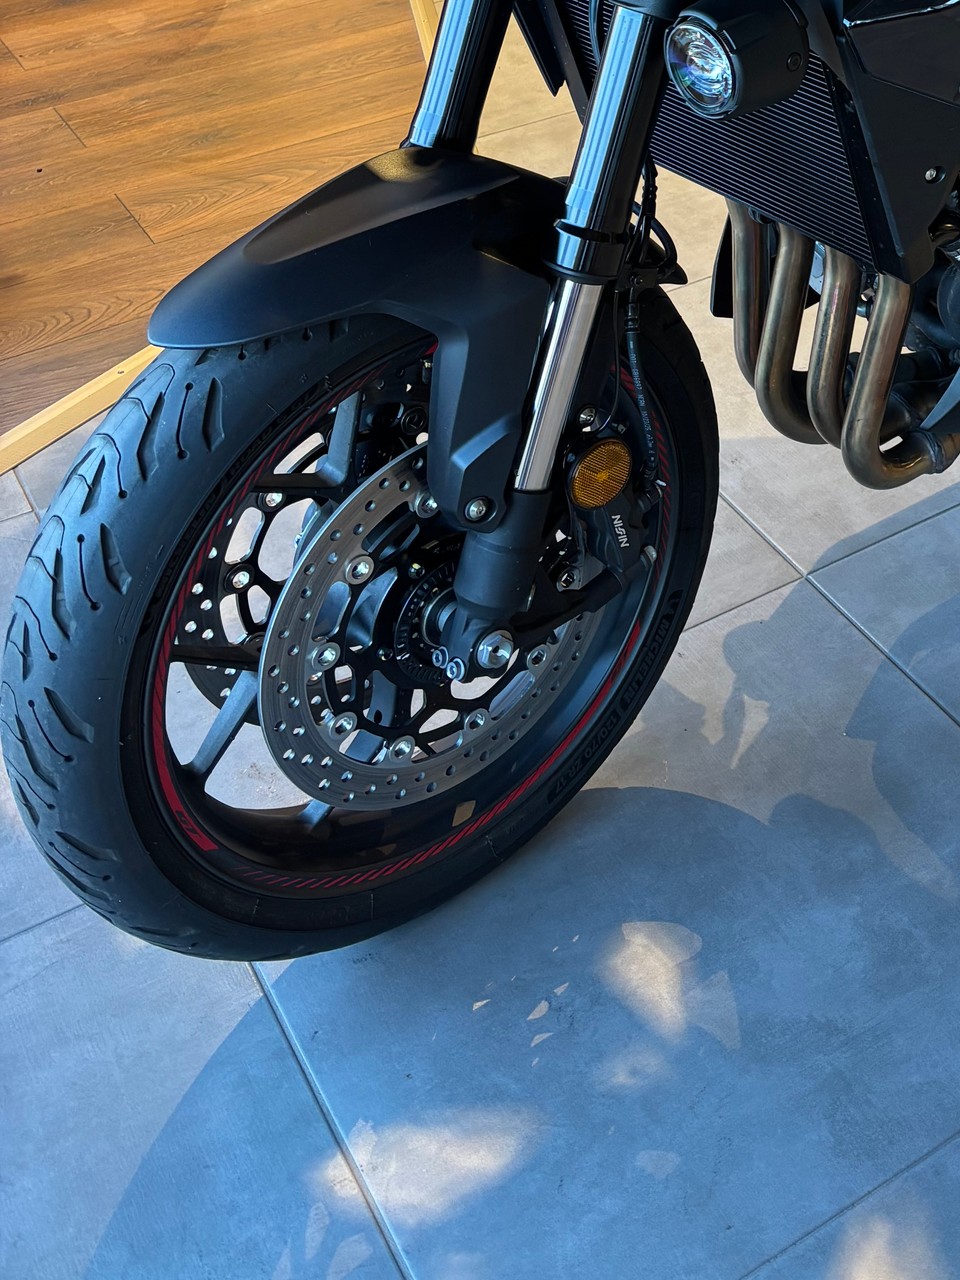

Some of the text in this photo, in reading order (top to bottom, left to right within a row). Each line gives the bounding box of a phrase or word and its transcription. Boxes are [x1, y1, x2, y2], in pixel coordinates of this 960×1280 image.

[611, 514, 630, 548] NISSIN
[622, 617, 671, 705] MICHELIN
[584, 712, 620, 759] 120/70
[556, 775, 570, 797] 17
